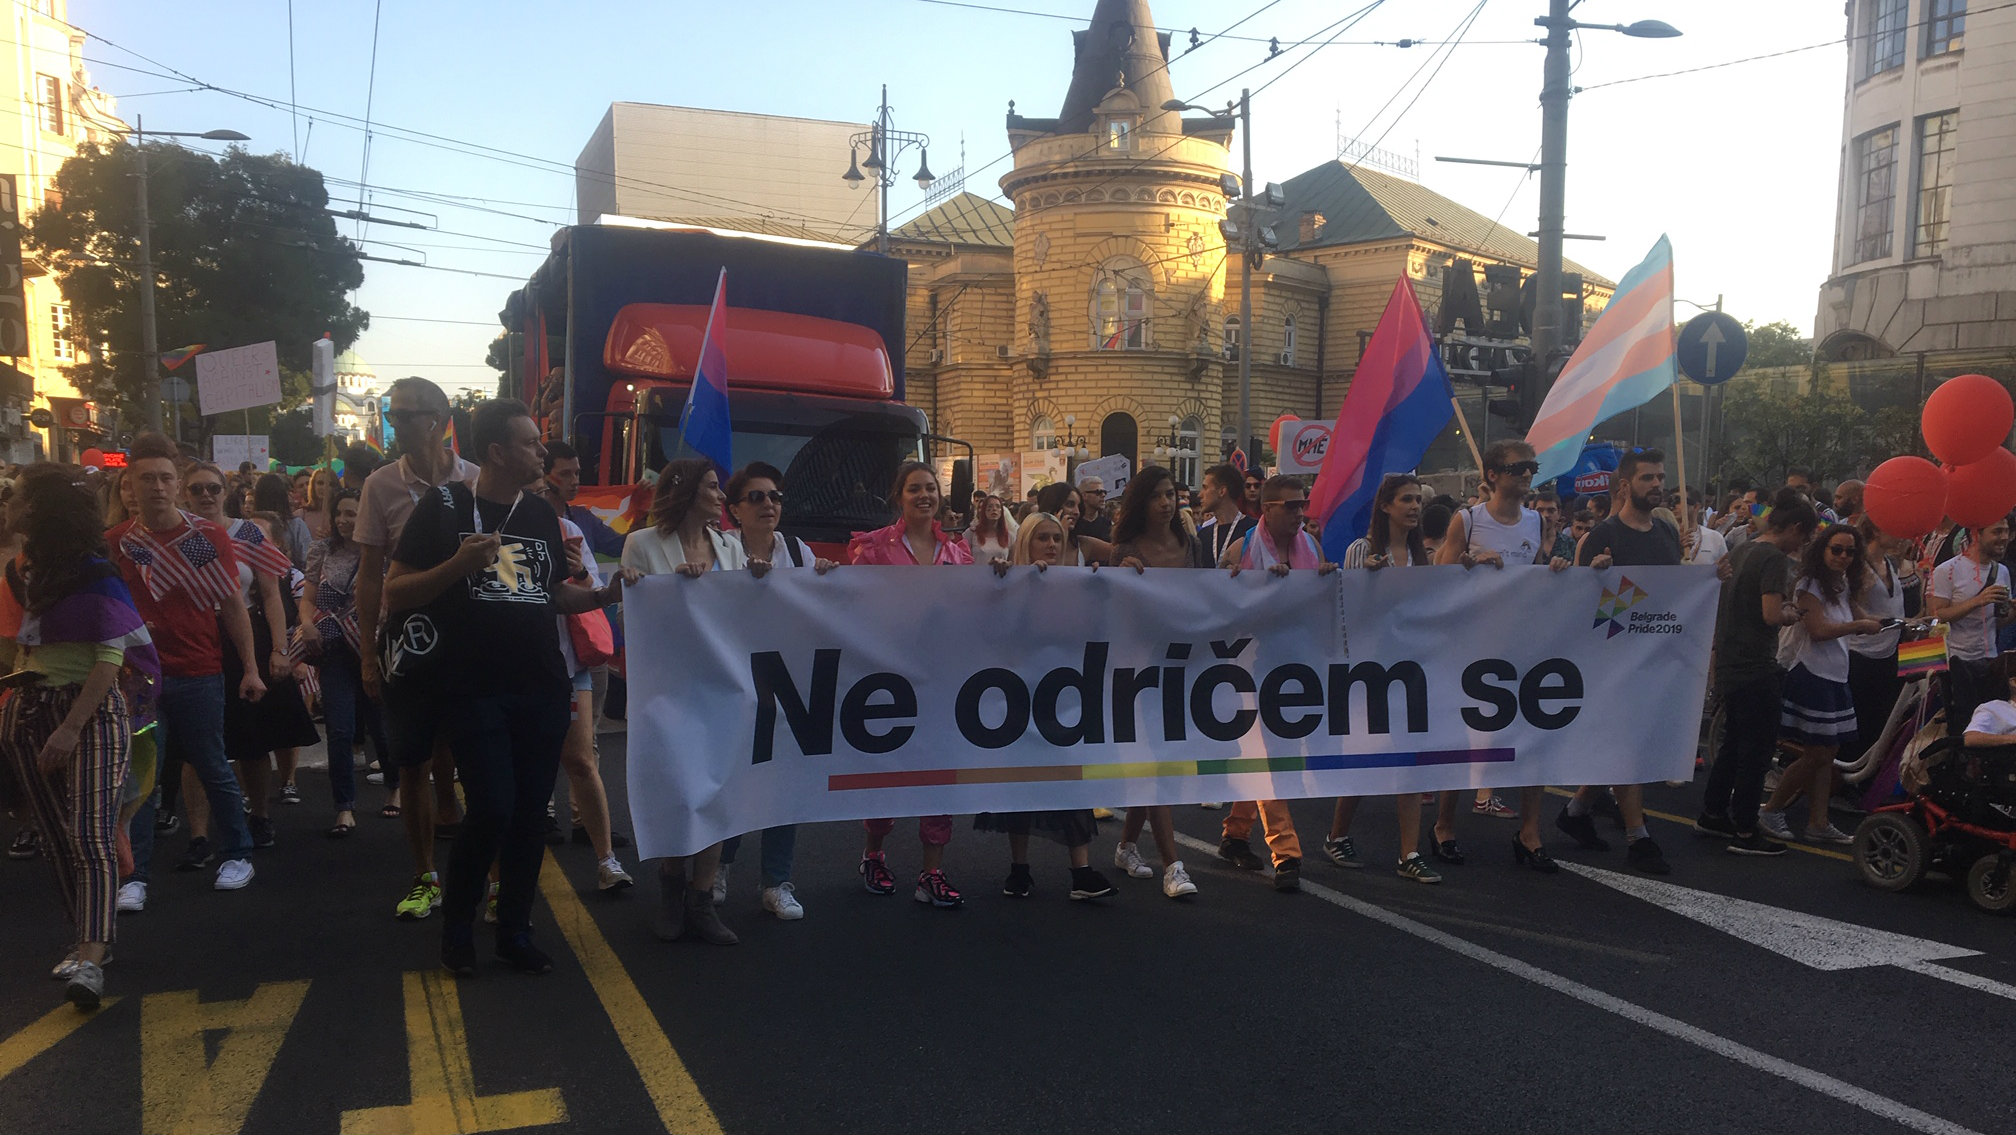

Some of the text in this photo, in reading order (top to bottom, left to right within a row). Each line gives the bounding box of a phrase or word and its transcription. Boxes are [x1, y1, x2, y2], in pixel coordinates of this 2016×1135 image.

[201, 345, 271, 372] QUEERS
[202, 362, 263, 387] AGAINST
[205, 378, 279, 409] CAPITALISM
[535, 542, 546, 561] DJ
[1628, 623, 1683, 634] Pride2019
[1630, 611, 1677, 623] Belgrade
[751, 640, 1584, 764] Ne odričem se
